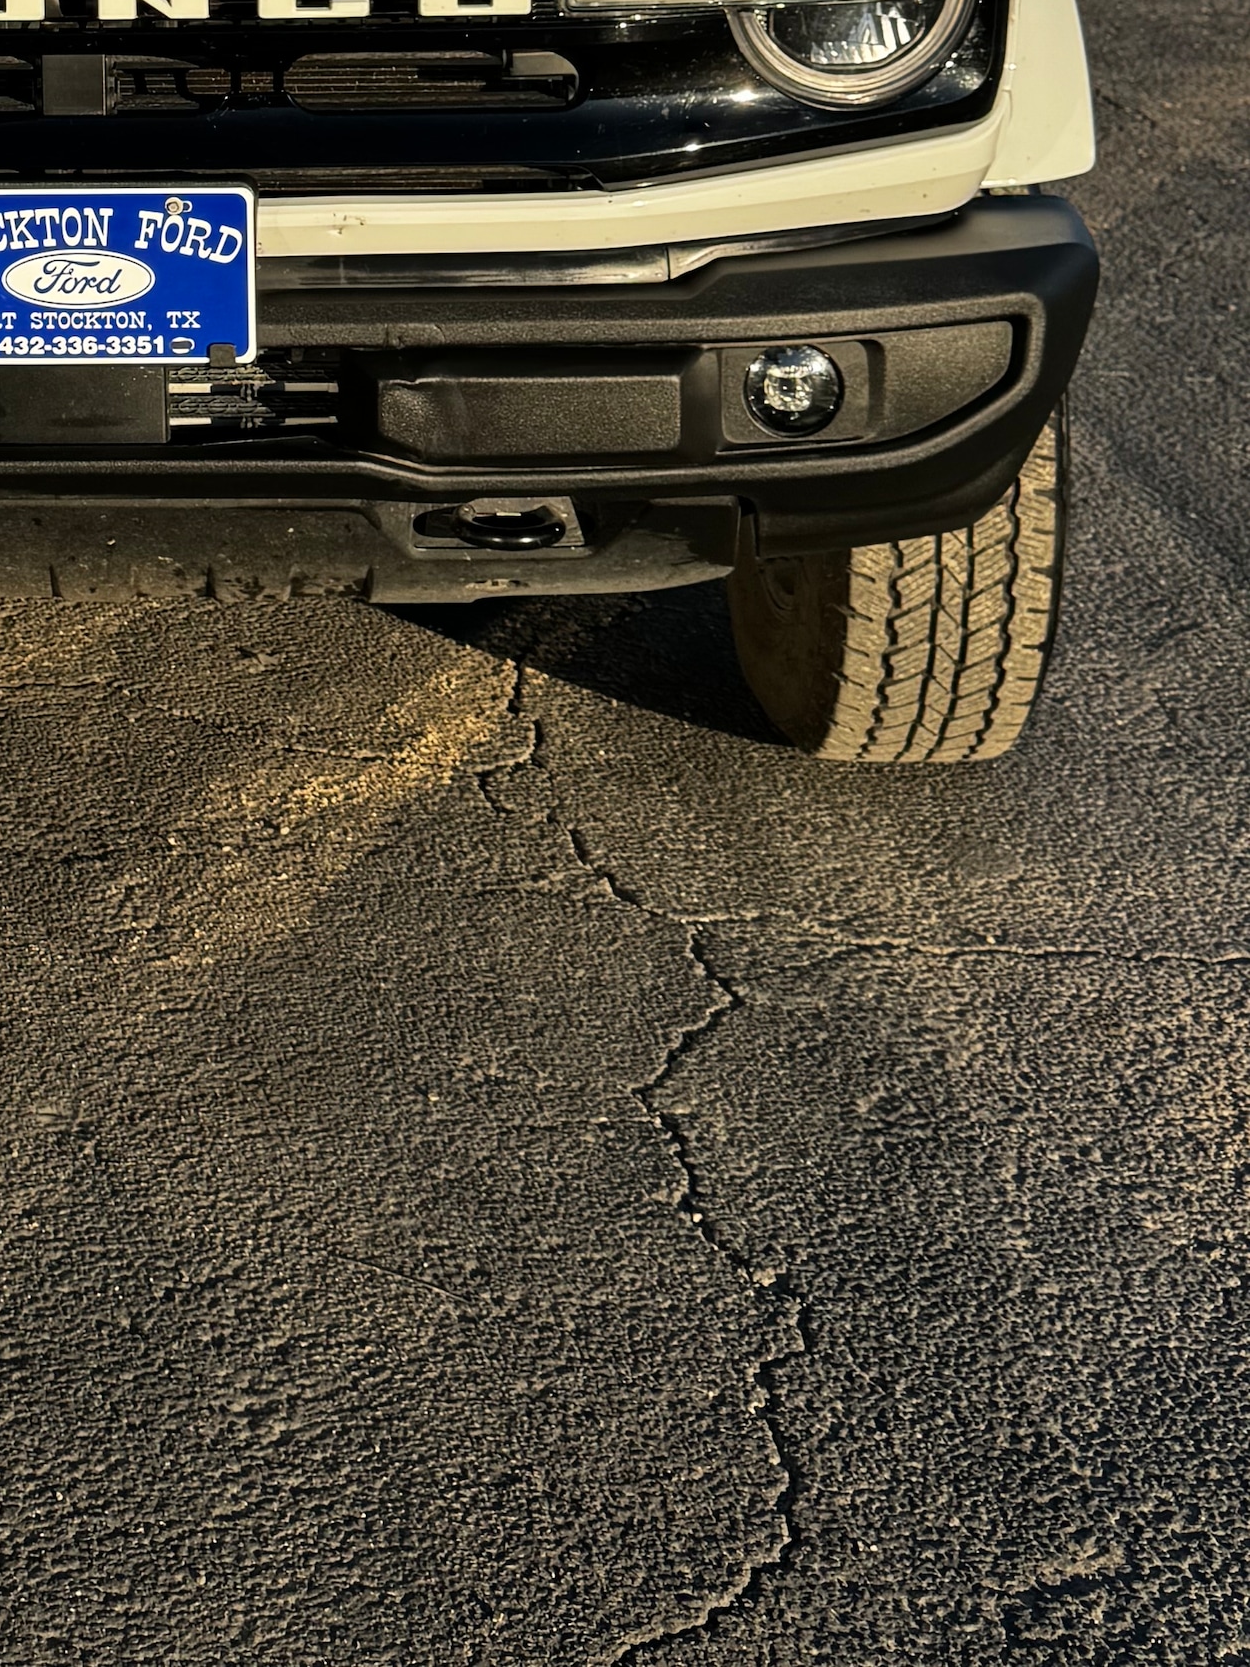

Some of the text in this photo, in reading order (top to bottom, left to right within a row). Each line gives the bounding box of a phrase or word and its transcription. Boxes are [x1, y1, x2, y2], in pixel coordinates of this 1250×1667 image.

[134, 210, 243, 264] FORD
[33, 259, 121, 295] Ford
[30, 311, 152, 332] STOCKTON,
[166, 311, 201, 329] TX
